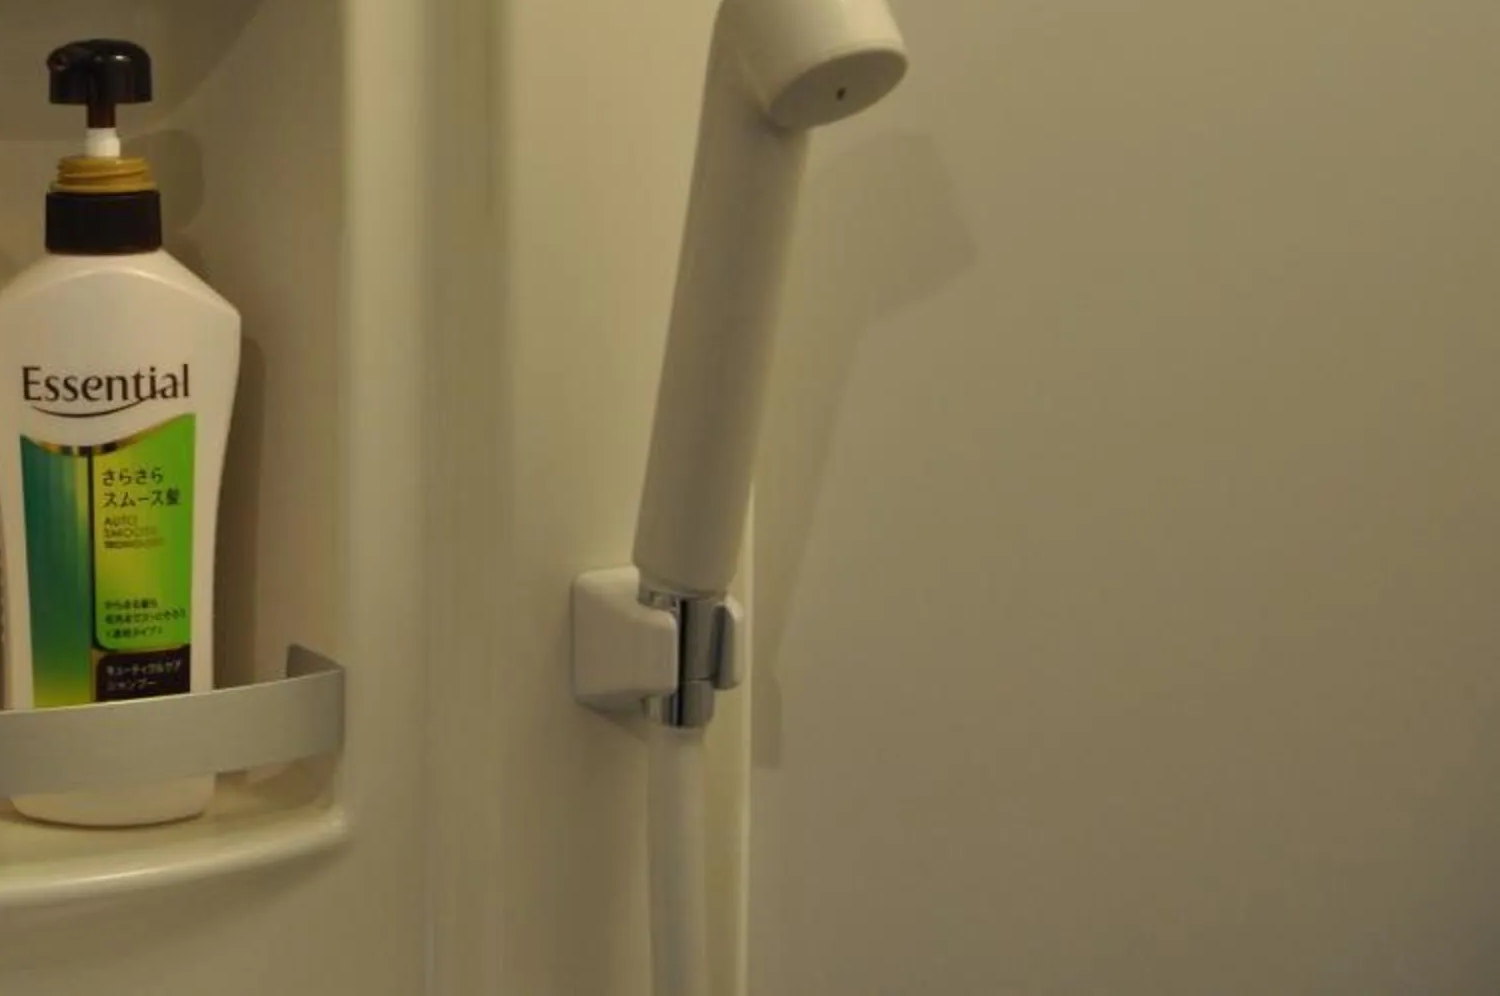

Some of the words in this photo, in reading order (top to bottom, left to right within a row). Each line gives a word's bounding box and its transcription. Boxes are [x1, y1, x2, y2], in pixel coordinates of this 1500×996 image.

[22, 364, 190, 403] Essential
[102, 468, 165, 487] さらさら
[103, 488, 182, 509] スムース髪
